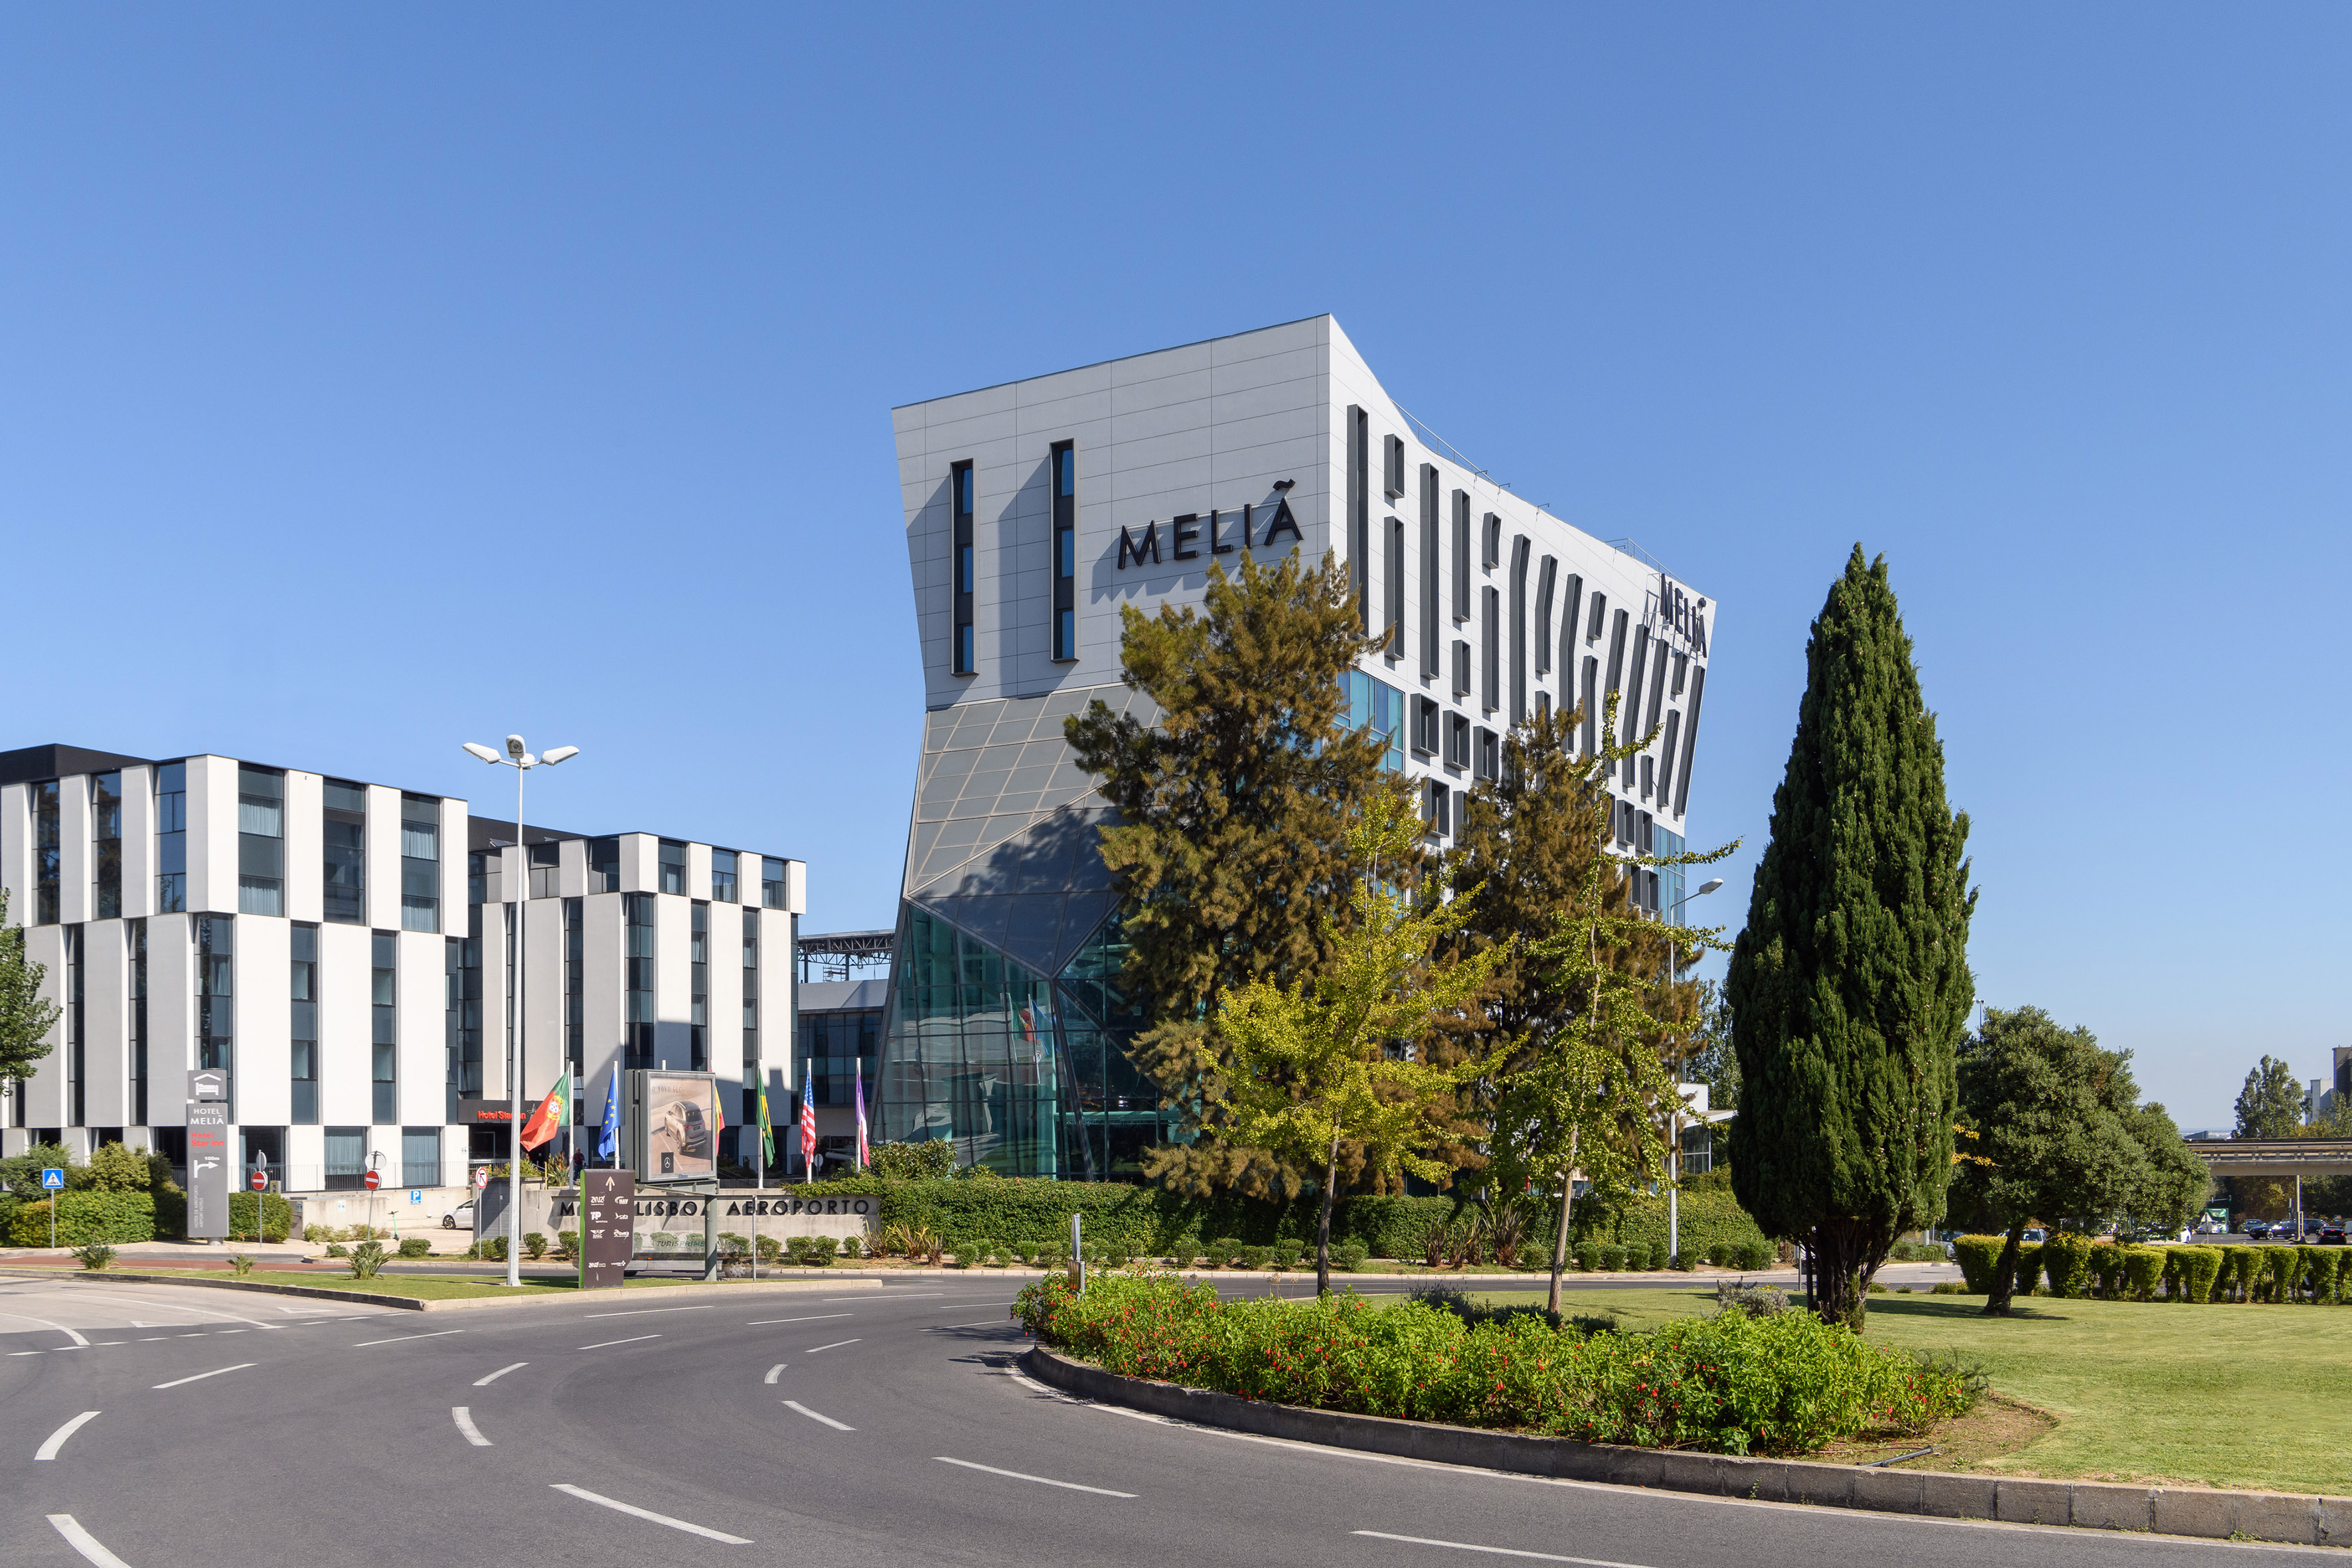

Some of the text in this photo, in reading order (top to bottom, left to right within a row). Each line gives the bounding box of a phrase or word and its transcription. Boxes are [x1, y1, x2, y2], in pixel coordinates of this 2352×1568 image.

[477, 1111, 498, 1119] Hotel
[498, 1111, 512, 1119] Sta
[413, 1191, 420, 1200] P
[637, 1200, 869, 1216] LISBO AEROPORTO
